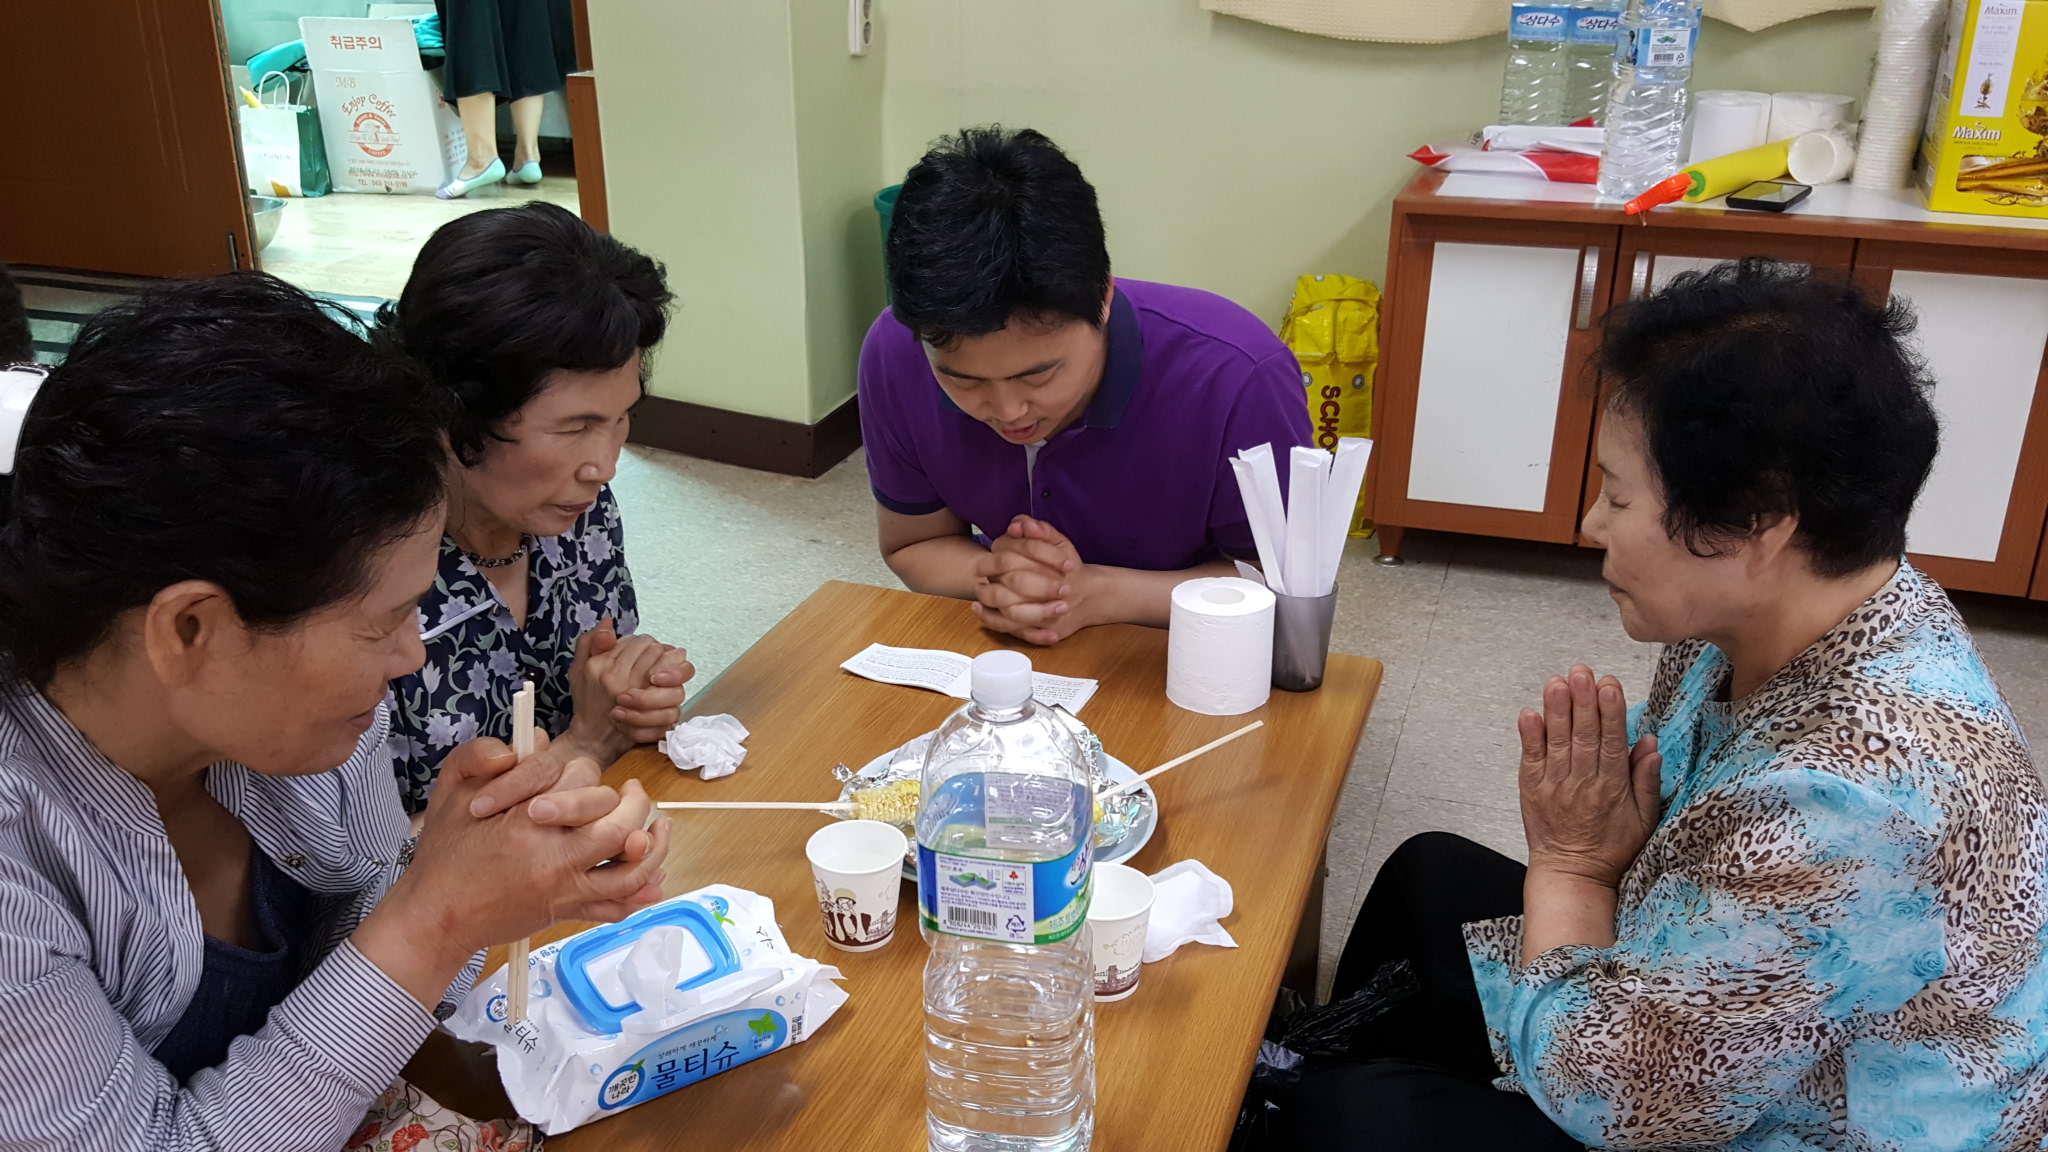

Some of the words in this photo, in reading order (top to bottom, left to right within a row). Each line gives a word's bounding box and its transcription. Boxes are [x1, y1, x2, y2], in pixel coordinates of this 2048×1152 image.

[1984, 4, 2018, 16] Maxim
[1526, 15, 1561, 27] 삼다수
[330, 35, 383, 51] 취급주의
[341, 96, 366, 116] Enjoy
[368, 93, 397, 119] Coffee
[1952, 123, 2002, 140] Maxim
[650, 1040, 740, 1090] 물티슈
[608, 1074, 638, 1094] 깨끗한
[611, 1085, 634, 1100] 나라
